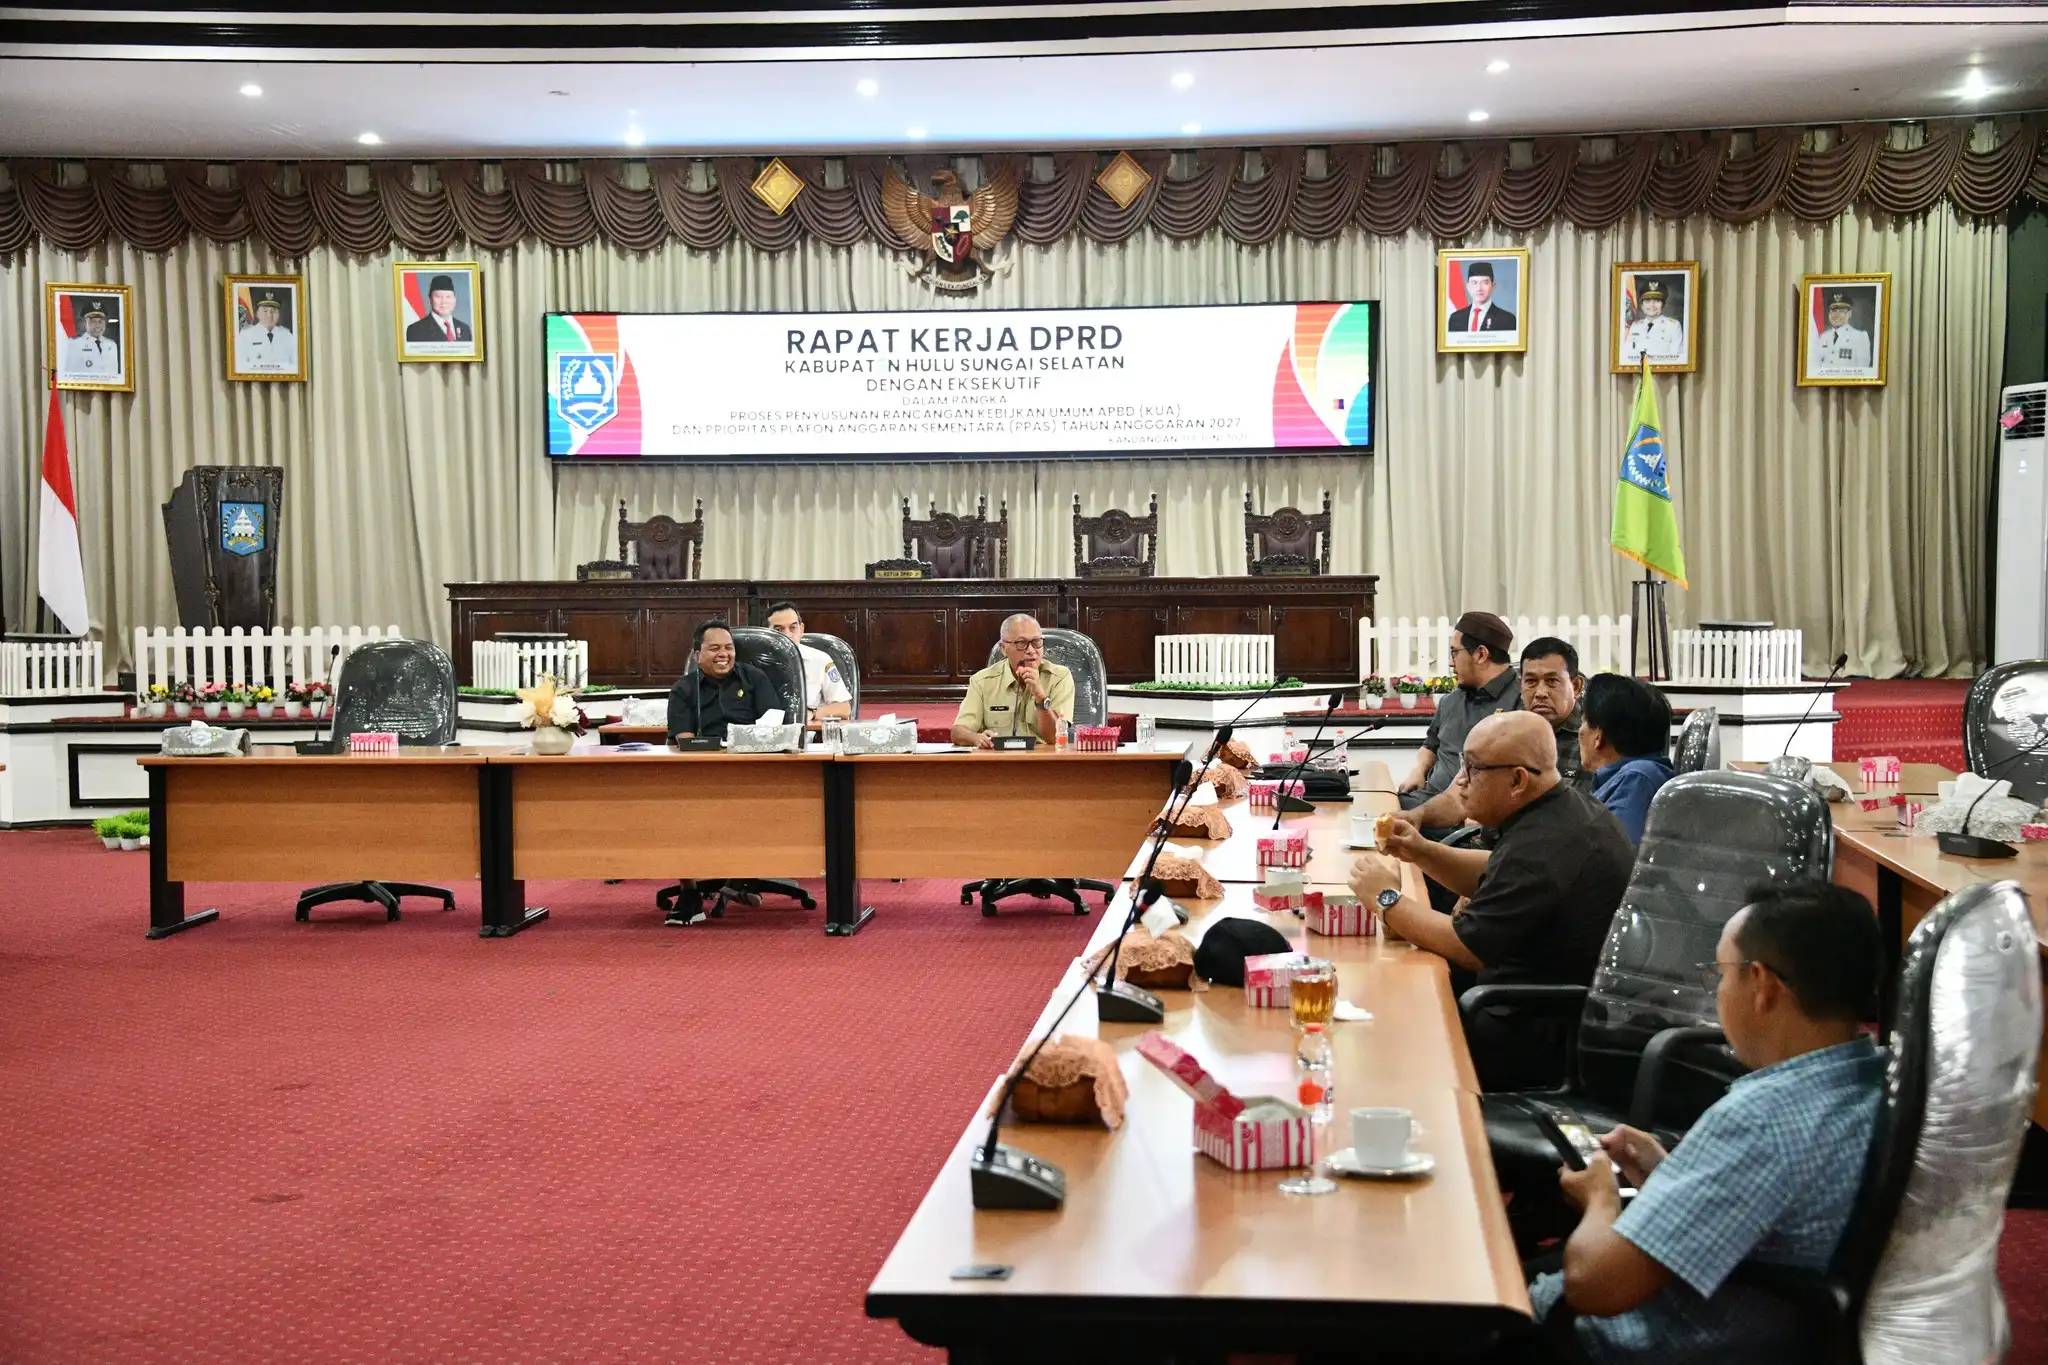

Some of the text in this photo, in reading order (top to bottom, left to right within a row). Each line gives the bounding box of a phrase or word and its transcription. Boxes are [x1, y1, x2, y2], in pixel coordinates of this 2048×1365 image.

[787, 325, 1123, 353] RAPAT KERJA DPRD
[785, 356, 1125, 373] KABUPATN HULU SUNGAI SELATAN
[866, 376, 1042, 391] DENGAN EKSEKUTIF
[902, 395, 1008, 406] DALAM RANGKA
[730, 403, 1182, 421] PROSES PENYUSUNAN RANCANGAN KEBIJKAN UMUM APBD (KUA)
[672, 417, 1242, 435] DAN PRIORITAS PLAFON ANGGARAN SEMENTARA (PPAS) TAHUN ANGGGARAN 2027
